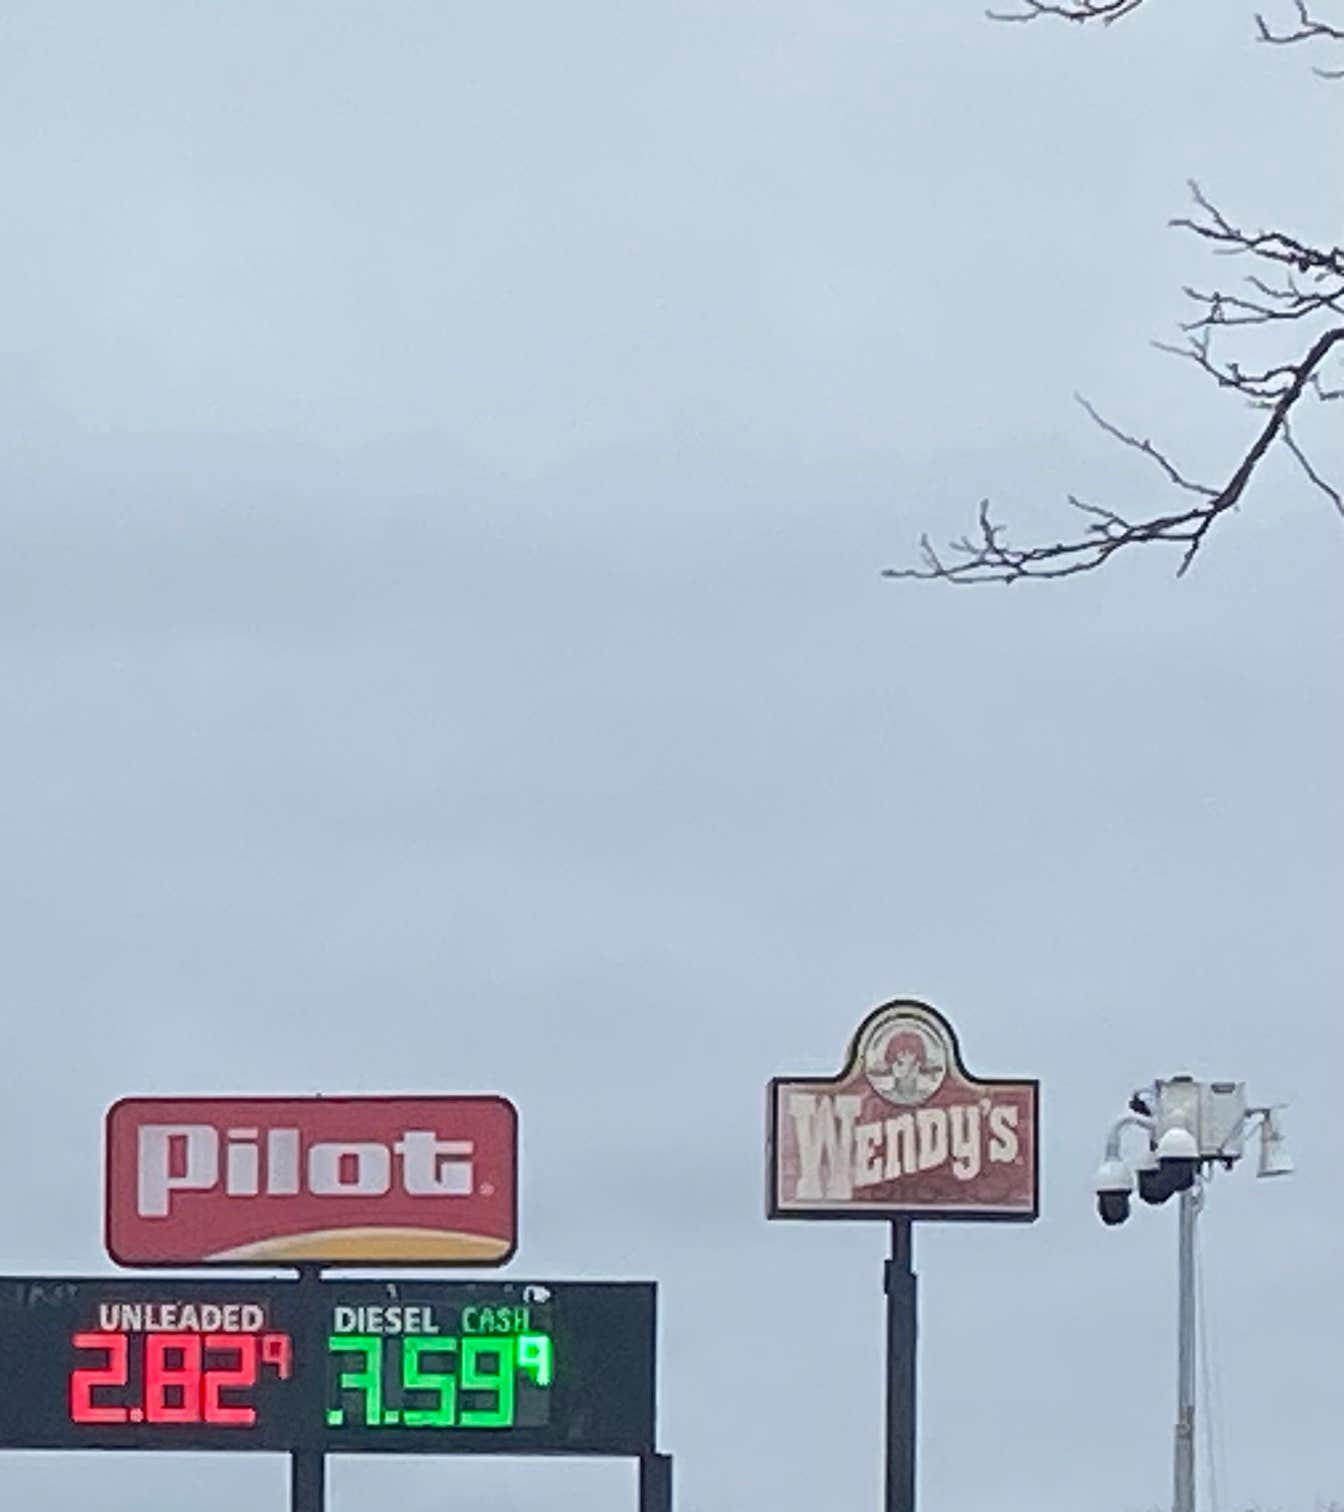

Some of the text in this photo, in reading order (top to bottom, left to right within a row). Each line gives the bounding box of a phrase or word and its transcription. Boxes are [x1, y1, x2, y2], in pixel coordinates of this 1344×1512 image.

[137, 1124, 474, 1217] Pilot
[99, 1304, 263, 1331] UNLEADED
[334, 1307, 529, 1333] DIESEL CASH
